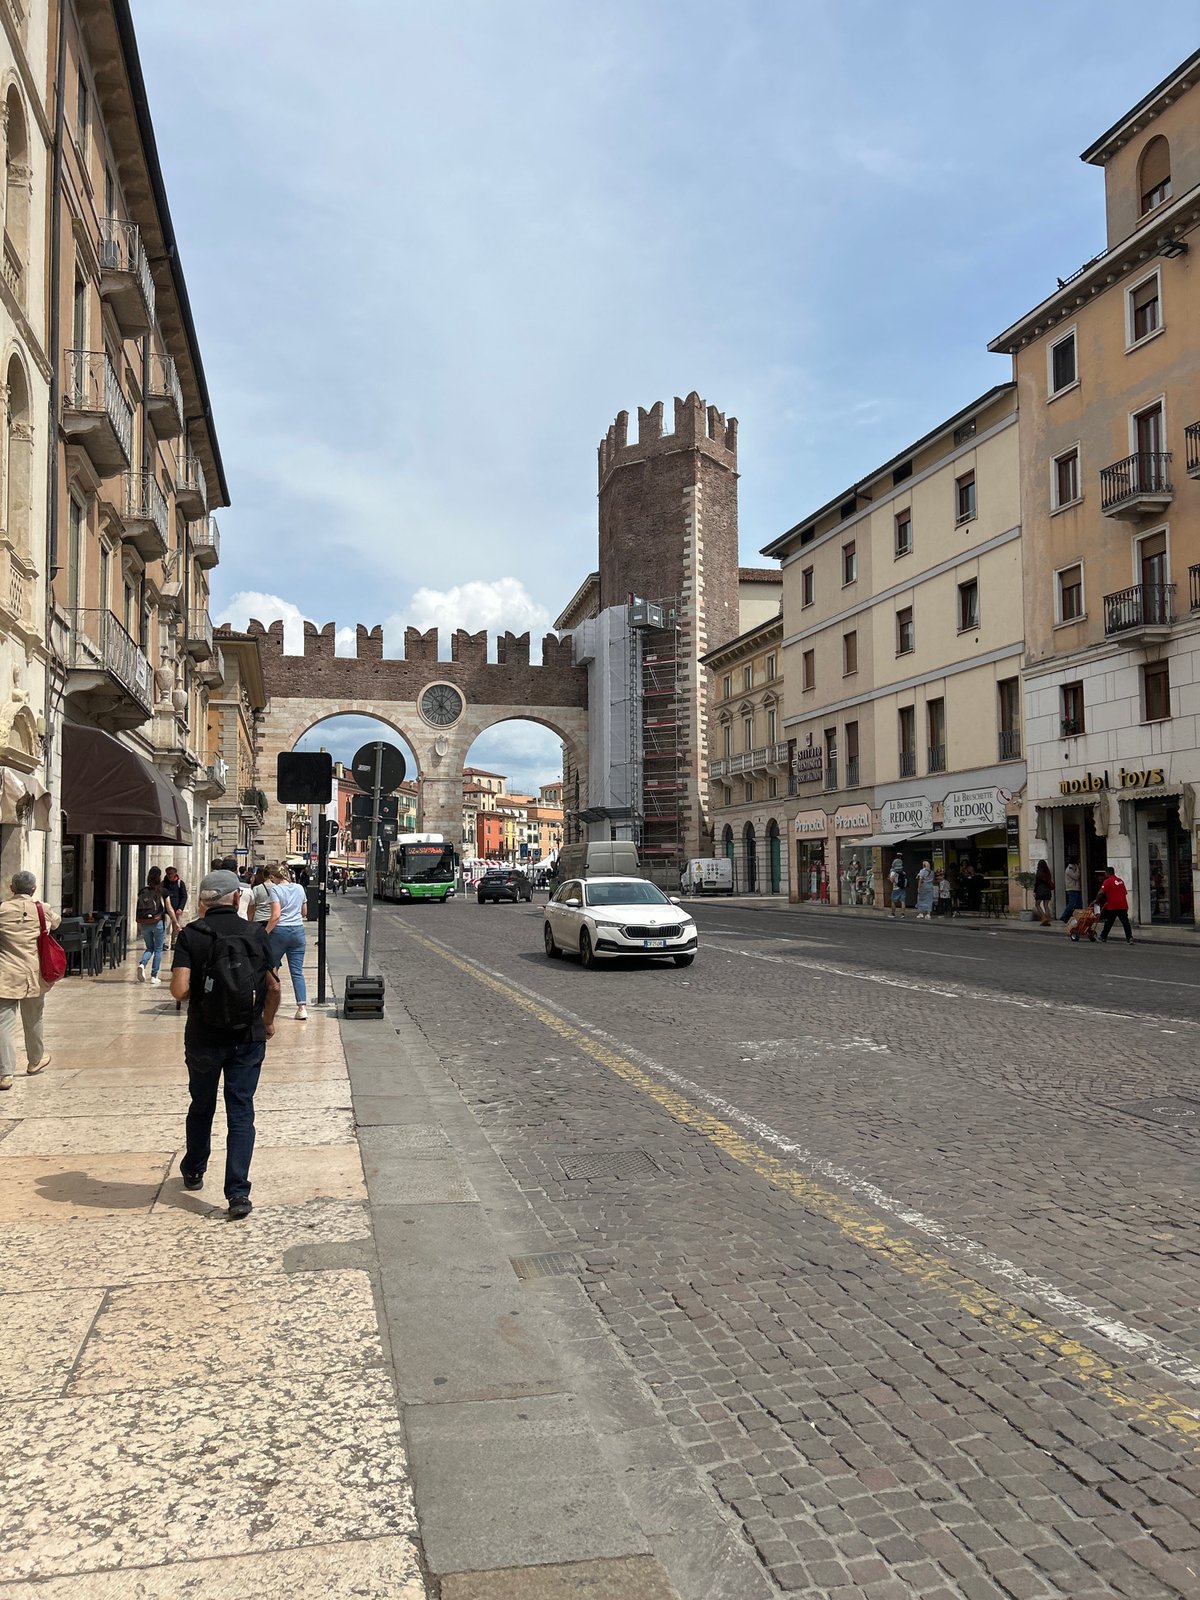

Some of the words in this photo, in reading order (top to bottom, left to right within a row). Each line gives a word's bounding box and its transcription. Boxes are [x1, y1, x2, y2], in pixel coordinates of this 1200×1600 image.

[1059, 770, 1109, 794] model
[1118, 767, 1165, 788] toys
[890, 808, 924, 829] REDORO
[953, 801, 994, 823] REDORO
